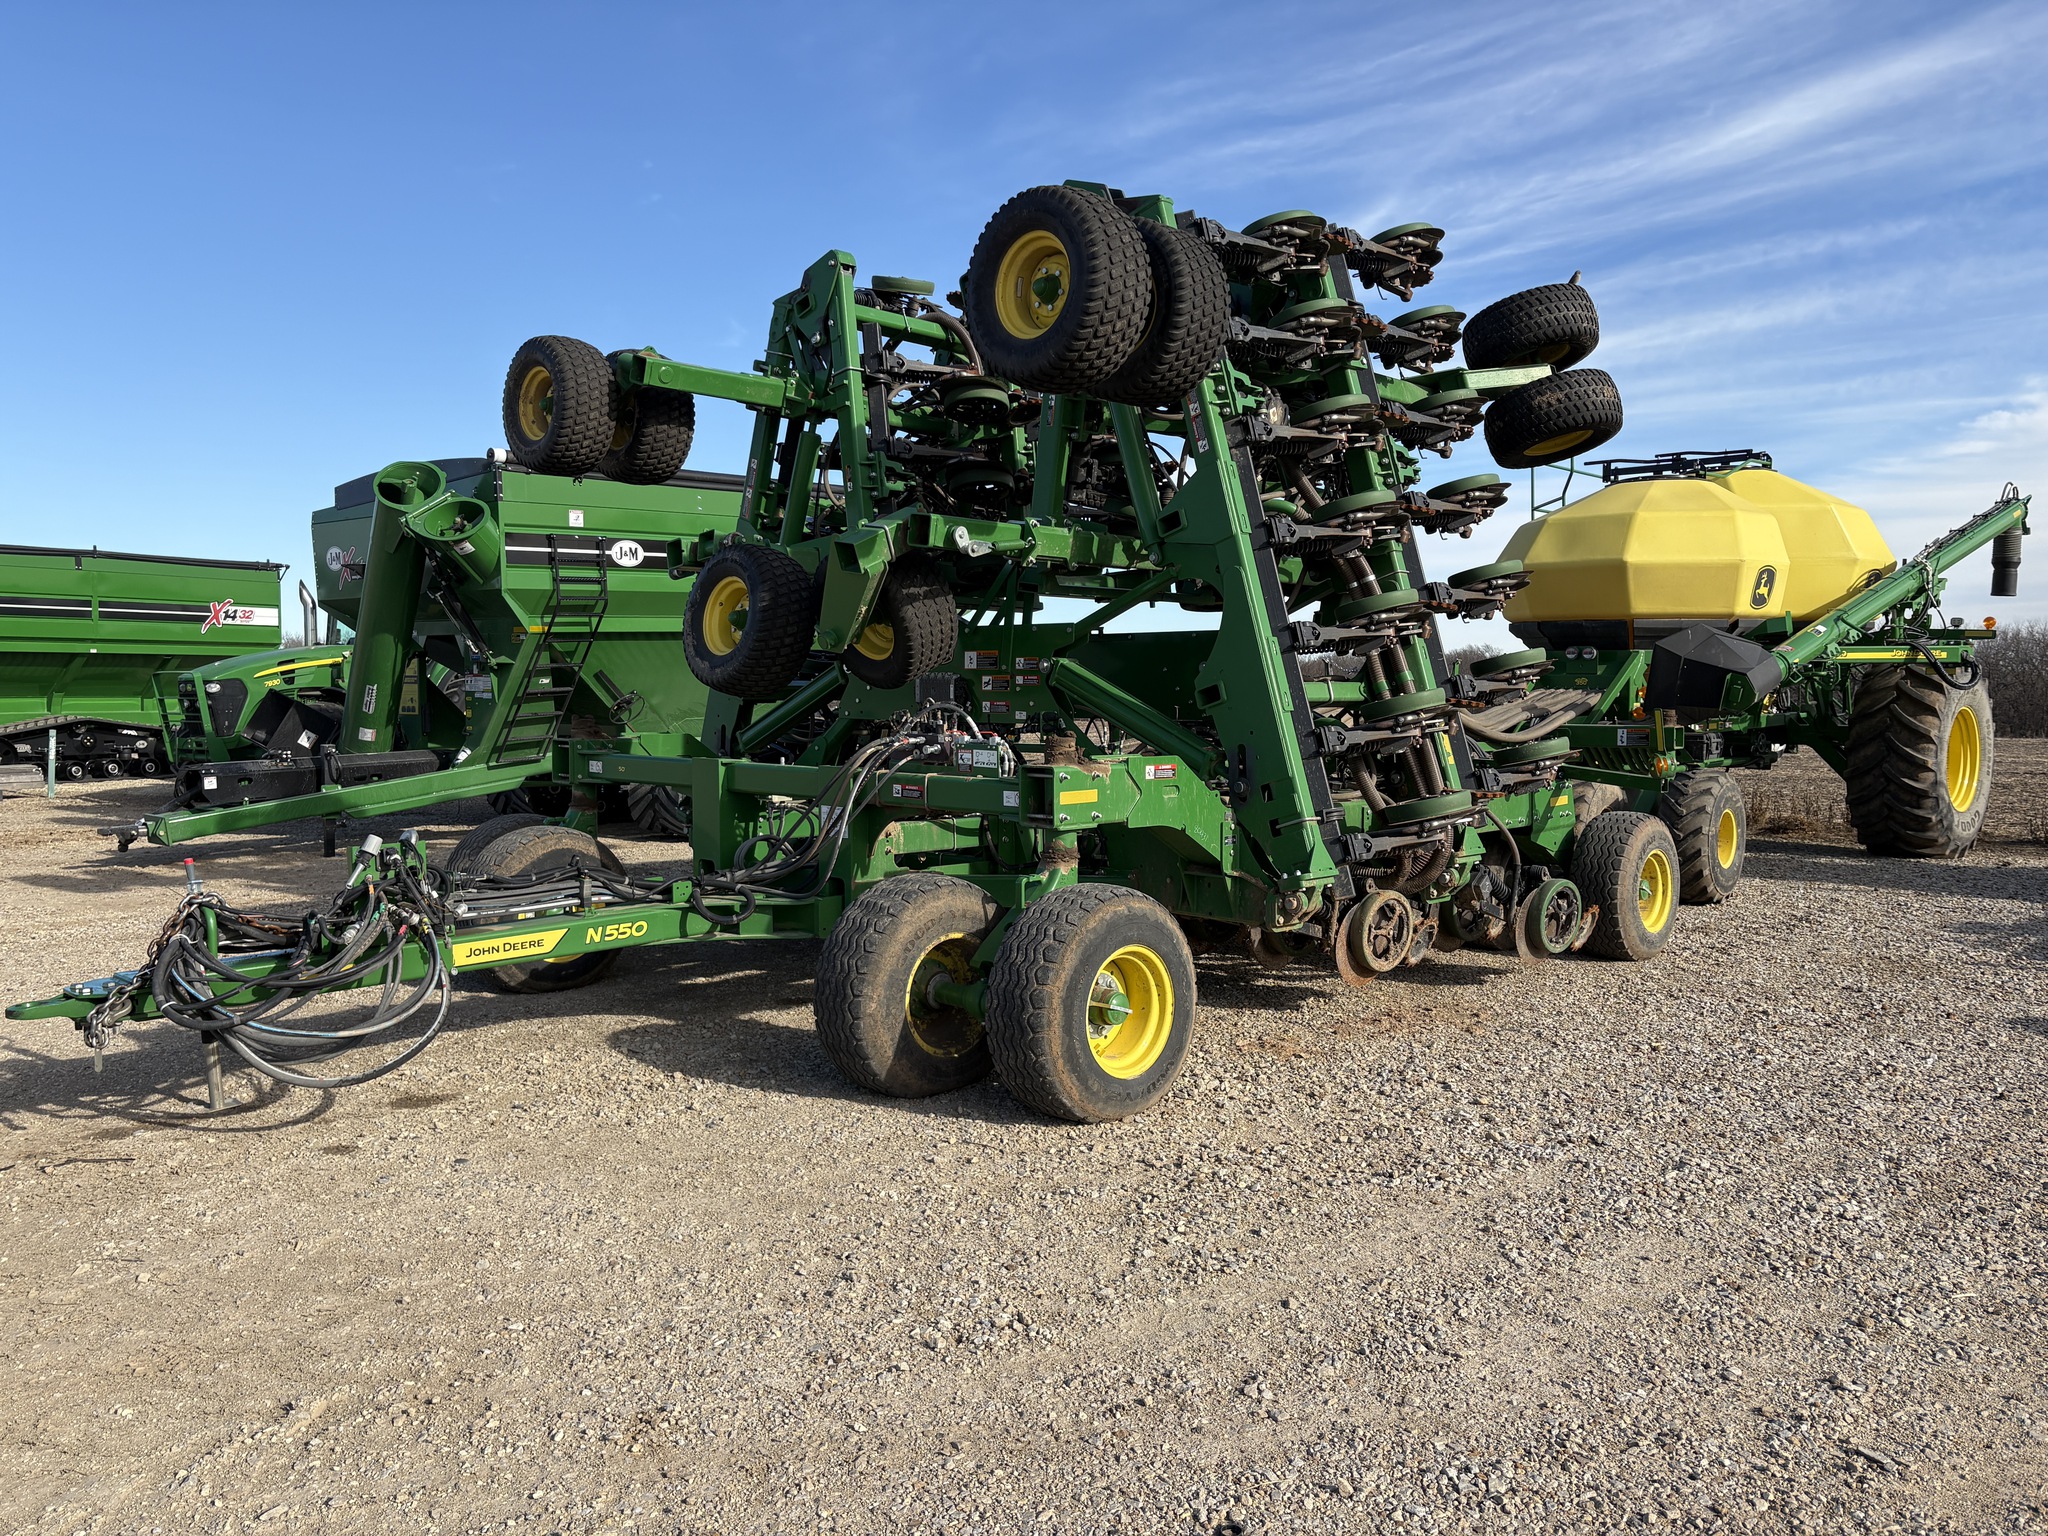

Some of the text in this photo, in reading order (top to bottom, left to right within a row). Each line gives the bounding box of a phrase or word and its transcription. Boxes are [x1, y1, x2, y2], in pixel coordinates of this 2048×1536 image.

[615, 546, 639, 561] J&M
[1890, 649, 1942, 658] JOHN DRE
[263, 678, 281, 688] 7930
[465, 938, 545, 958] JOHN DEERE
